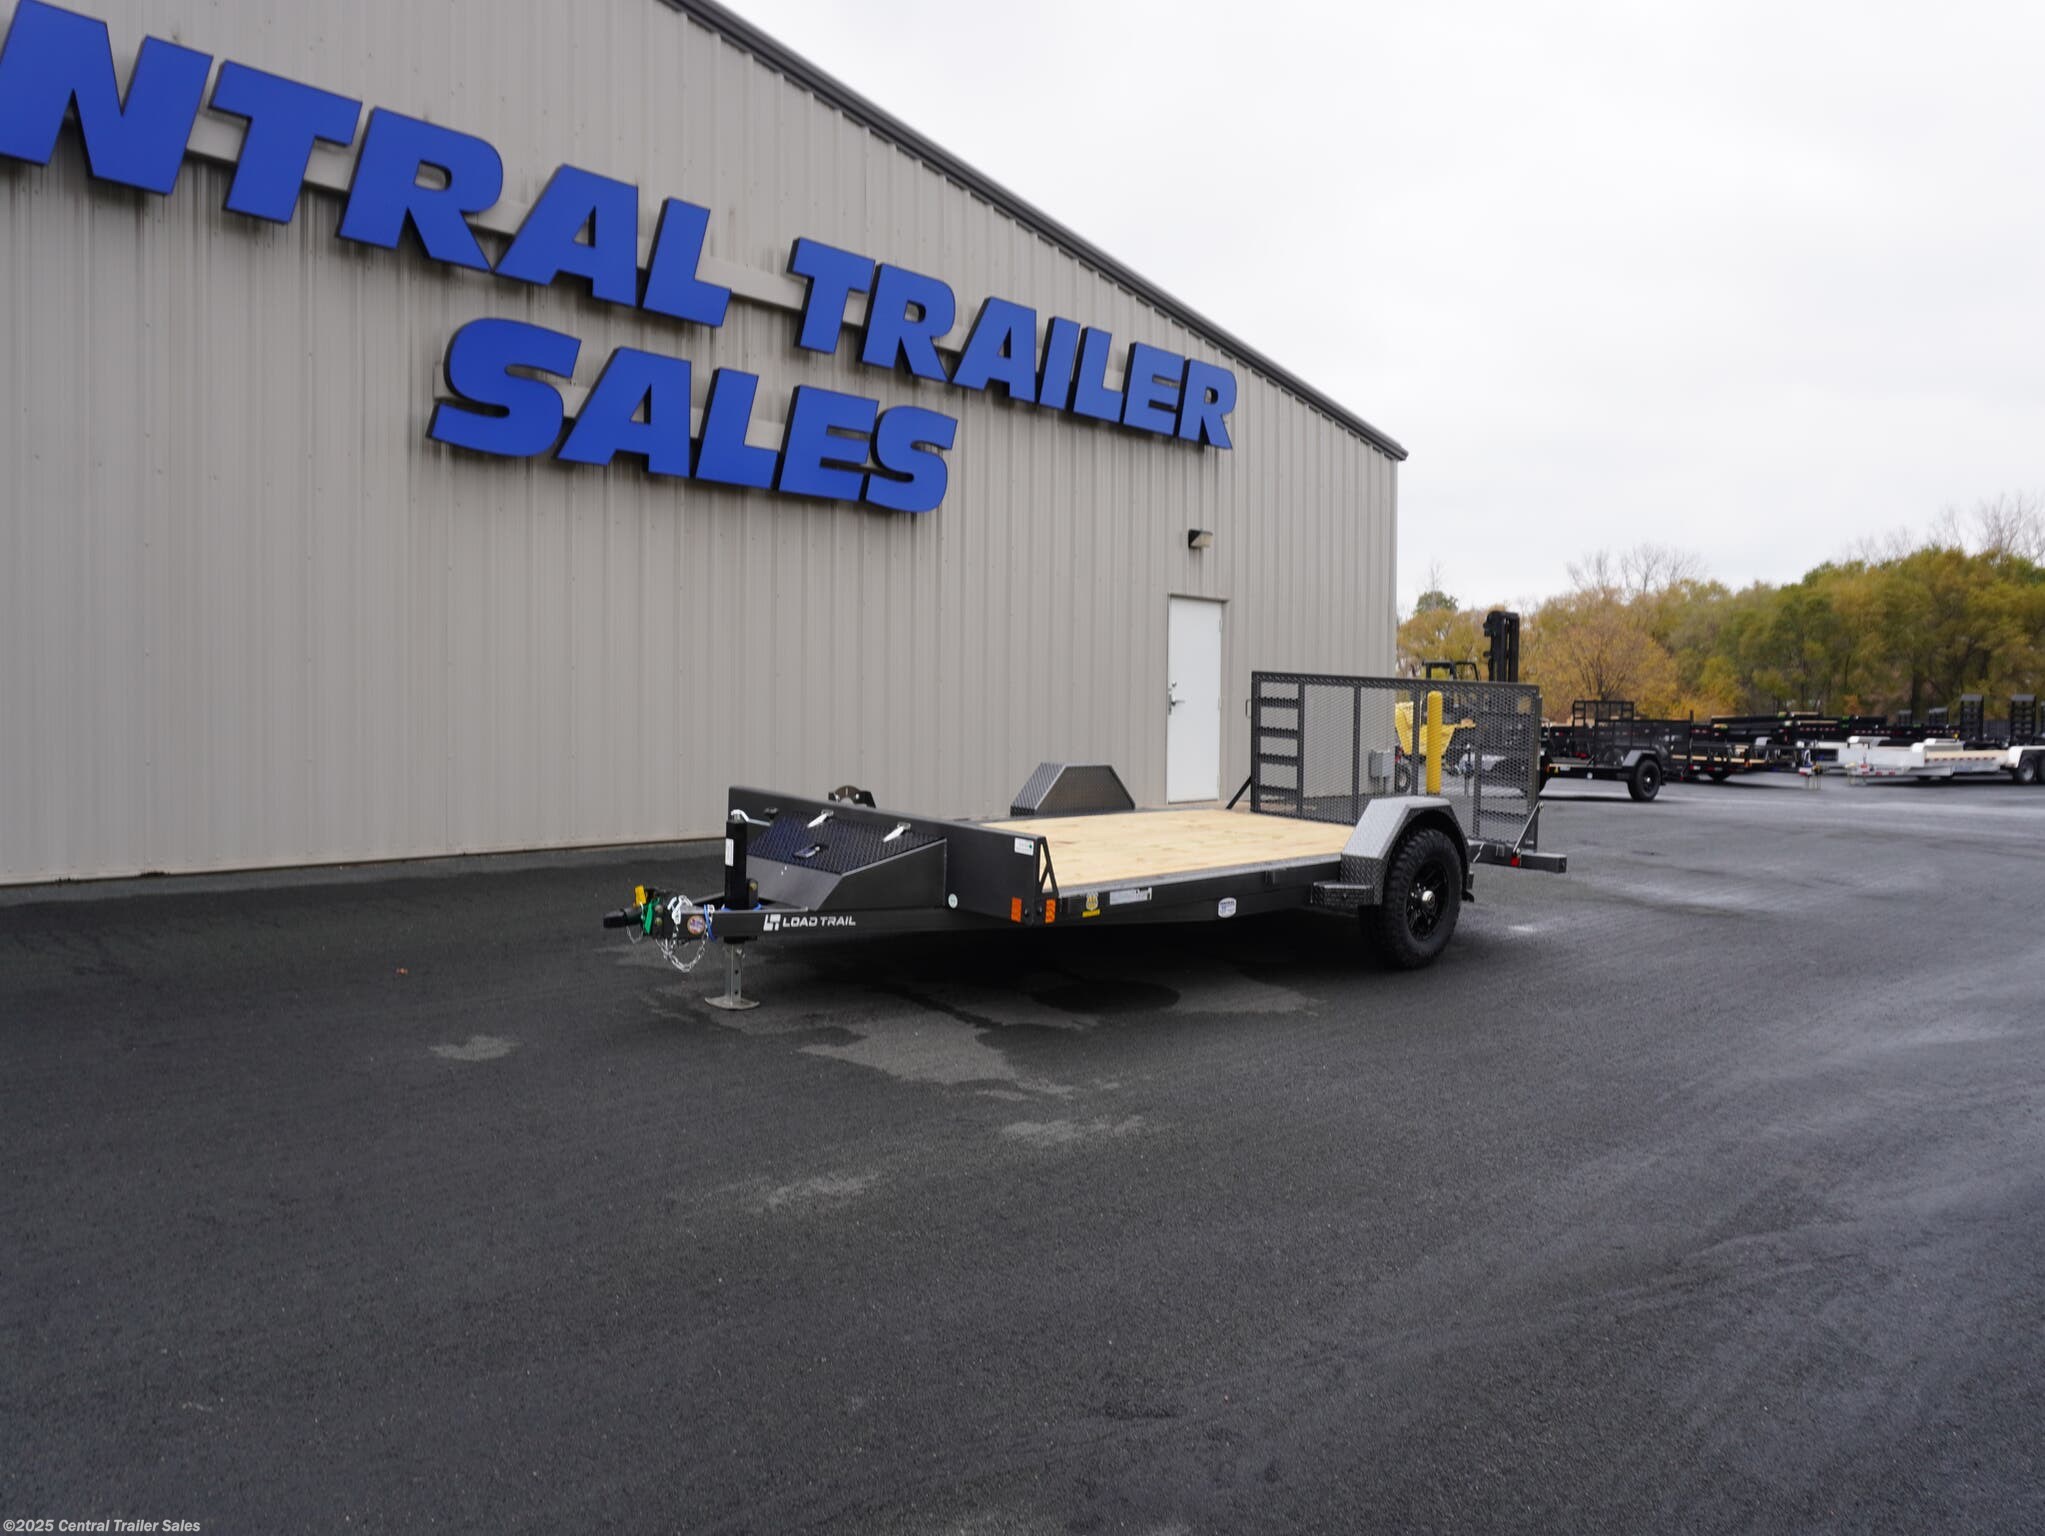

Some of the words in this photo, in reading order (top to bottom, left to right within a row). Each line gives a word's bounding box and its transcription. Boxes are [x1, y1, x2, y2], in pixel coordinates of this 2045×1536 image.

[0, 0, 732, 328] NTRAL
[788, 237, 1237, 450] TRAILER
[428, 318, 957, 513] SALES
[783, 916, 818, 927] LOAD
[820, 916, 856, 927] TRAIL
